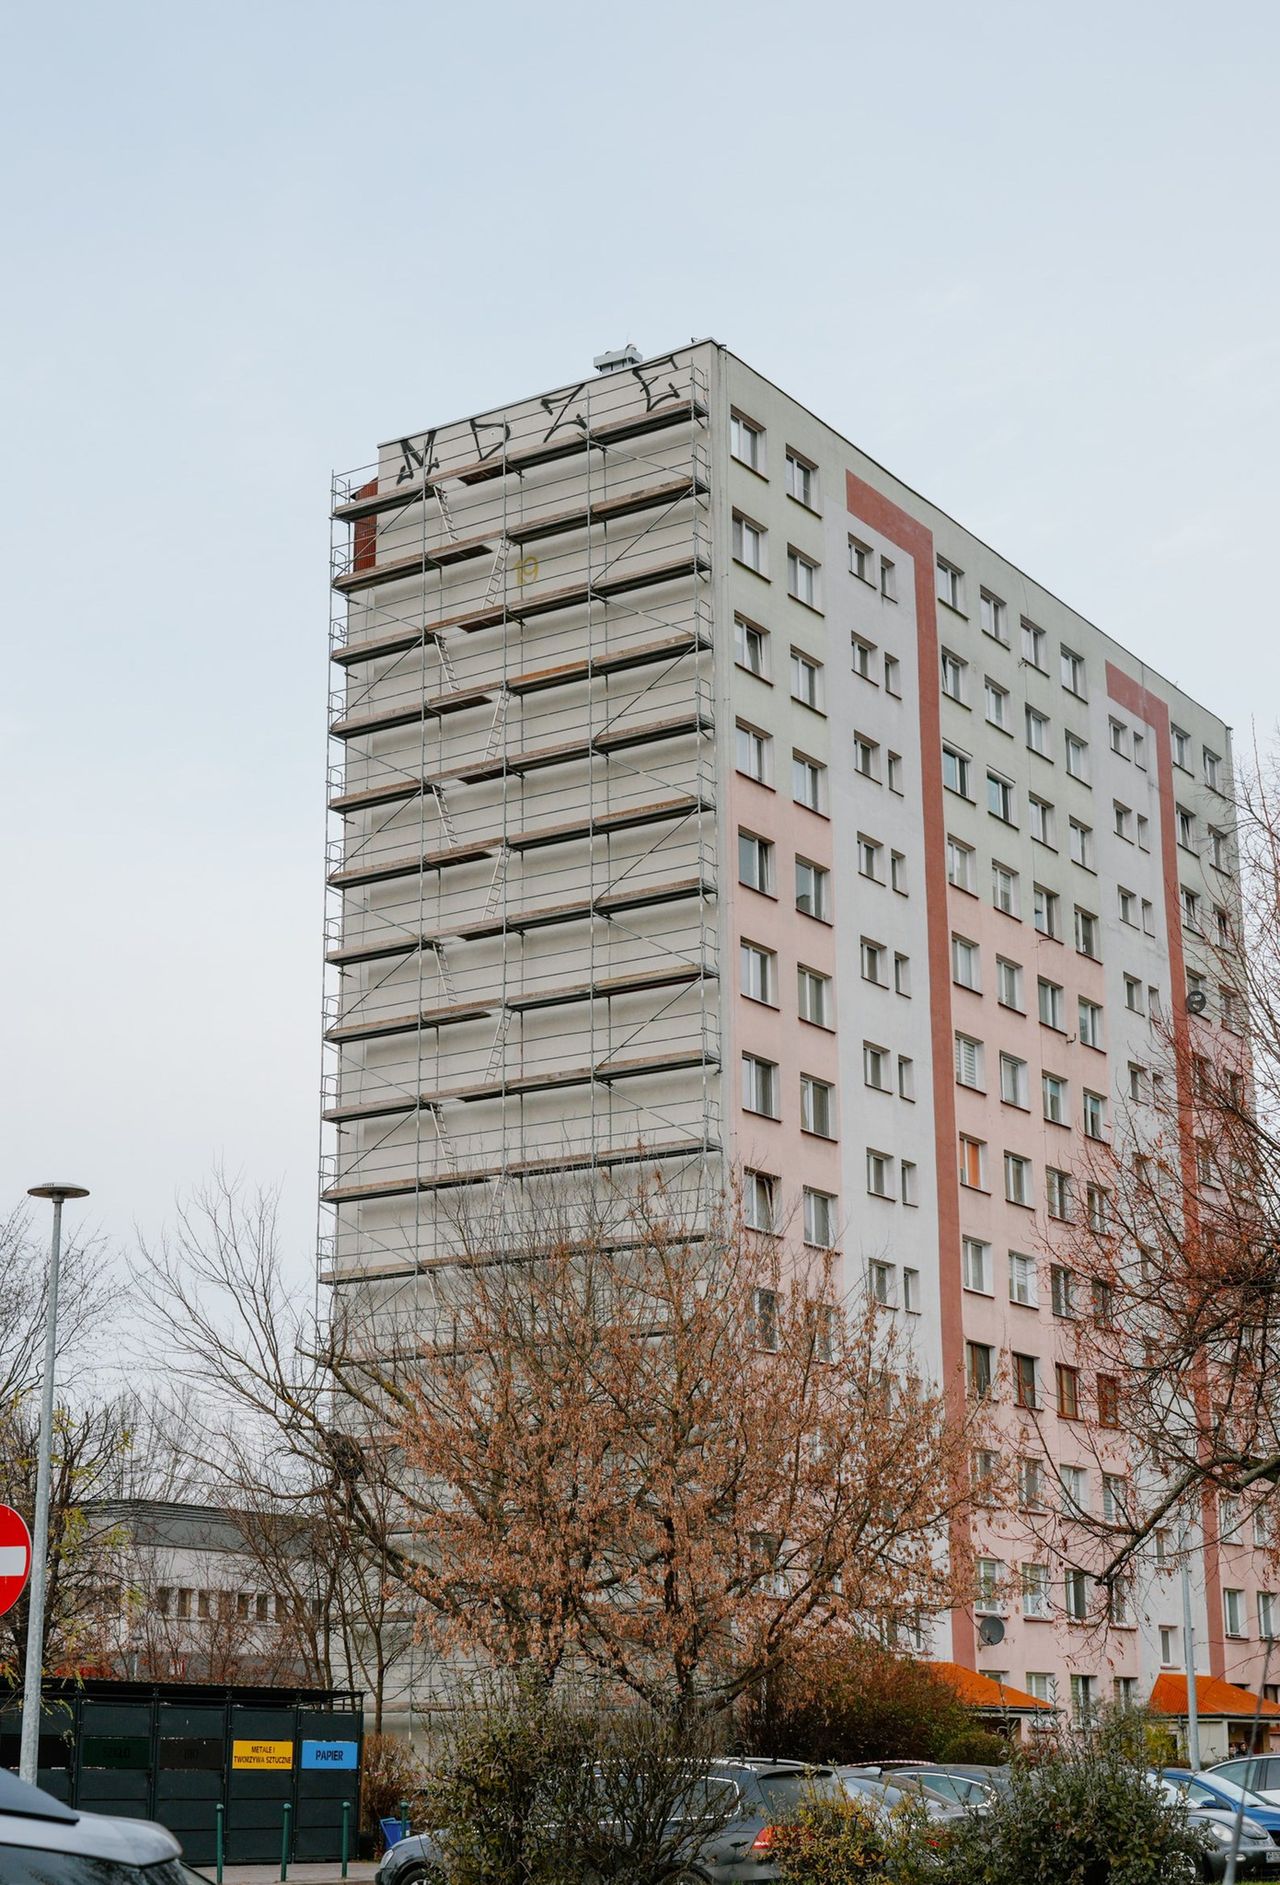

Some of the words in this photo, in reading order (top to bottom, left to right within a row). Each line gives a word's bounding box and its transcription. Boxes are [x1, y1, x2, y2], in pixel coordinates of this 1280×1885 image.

[251, 1745, 273, 1753] METALE
[234, 1755, 265, 1764] TWORZYWA
[265, 1756, 292, 1764] SZTUCZNE
[315, 1749, 344, 1761] PAPIER
